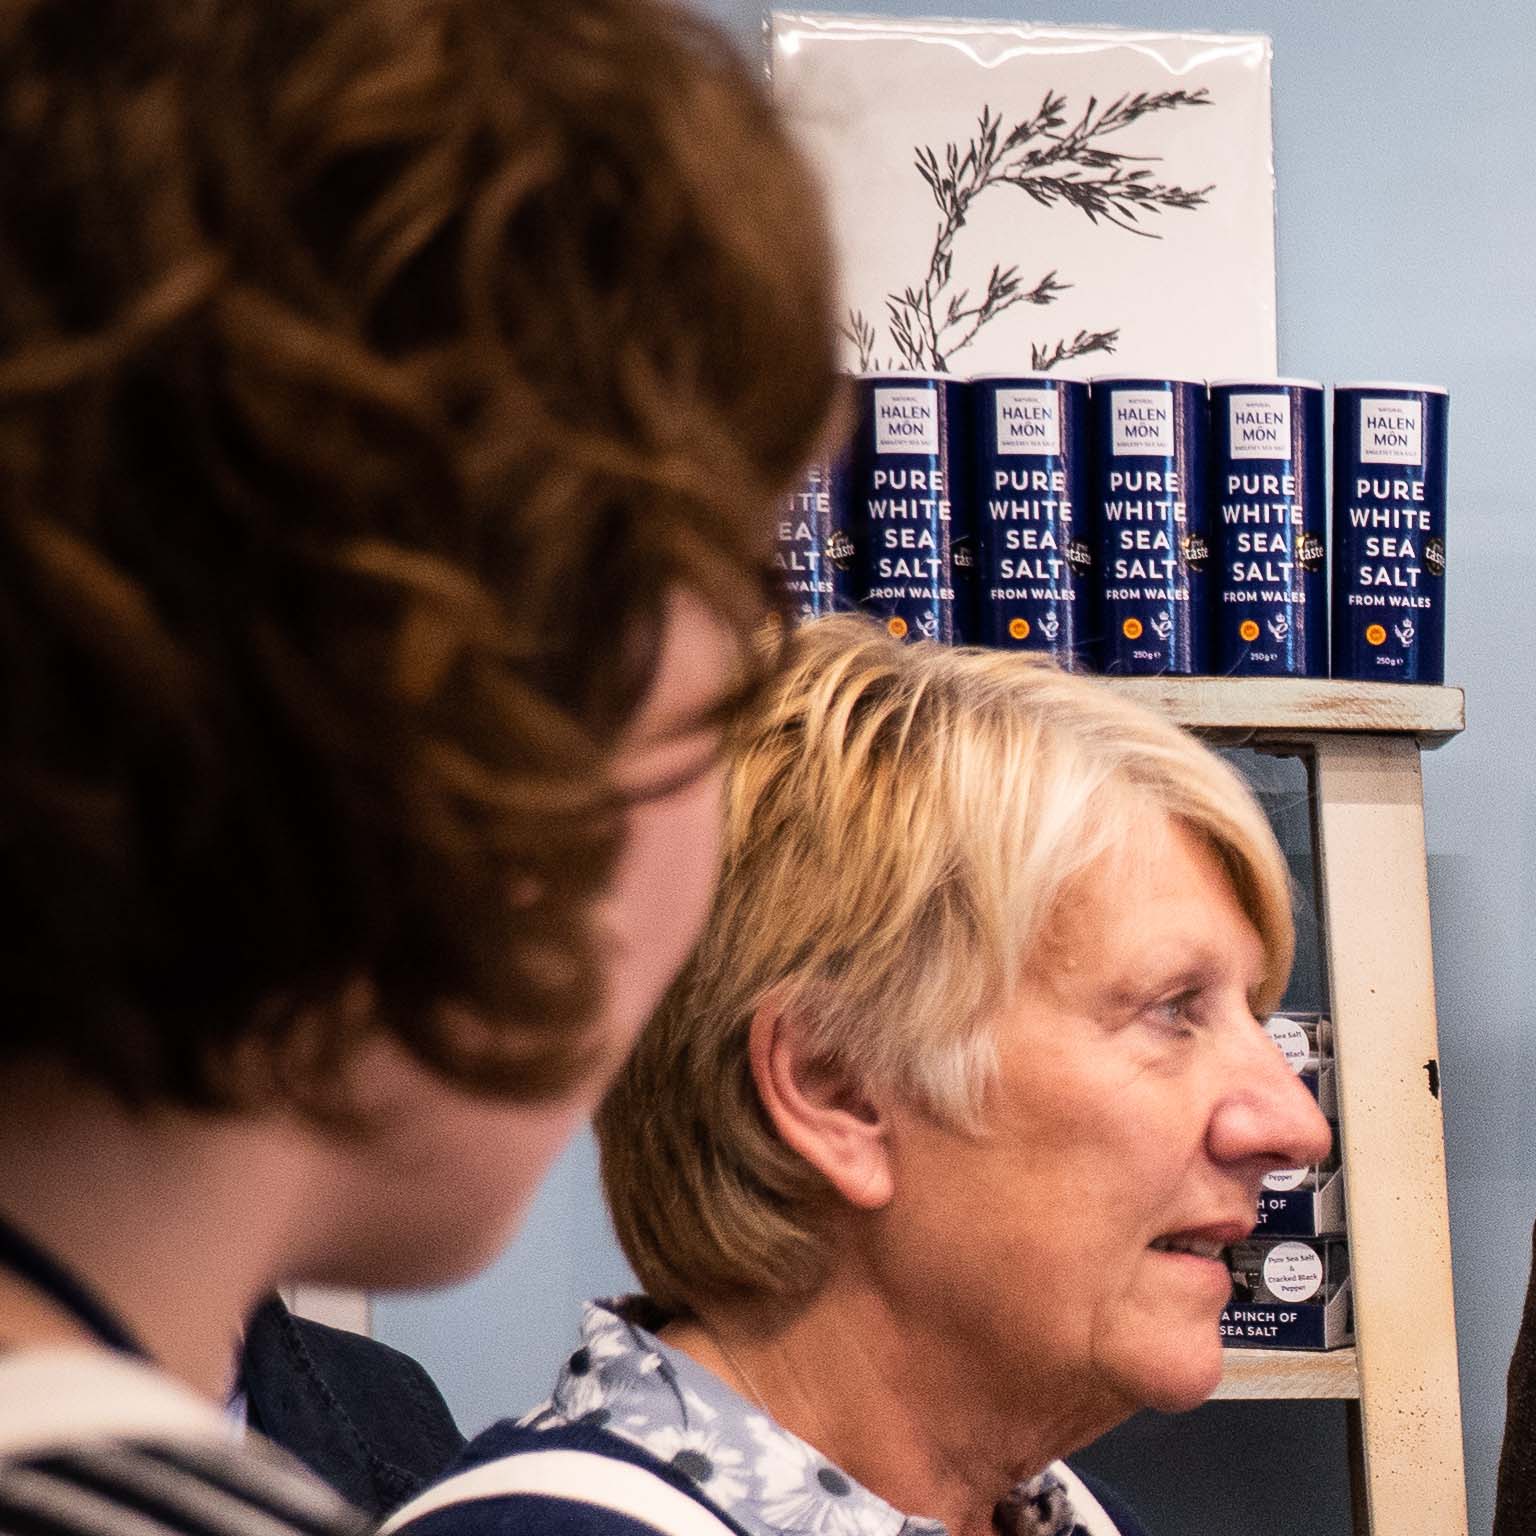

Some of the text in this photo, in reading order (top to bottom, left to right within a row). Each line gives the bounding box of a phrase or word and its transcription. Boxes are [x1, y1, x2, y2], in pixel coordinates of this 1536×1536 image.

[881, 407, 931, 419] HALEN
[1002, 408, 1052, 420] HALEN
[1118, 408, 1166, 420] HALEN
[1236, 411, 1284, 424] HALEN
[888, 420, 923, 435] MÔN
[1010, 420, 1045, 436] MÔN
[1125, 422, 1159, 437] MÔN
[1243, 426, 1277, 441] MÔN
[1367, 416, 1416, 431] HALEN
[1374, 431, 1408, 446] MÔN
[874, 470, 943, 491] PURE
[995, 471, 1065, 492] PURE
[1111, 472, 1179, 492] PURE
[1228, 475, 1295, 495] PURE
[1357, 479, 1424, 501] PURE
[868, 500, 951, 521] WHITE
[989, 501, 1072, 522] WHITE
[1105, 501, 1186, 523] WHITE
[1223, 504, 1303, 525] WHITE
[1350, 508, 1431, 531] WHITE
[885, 529, 935, 549] SEA
[1006, 530, 1058, 550] SEA
[1120, 530, 1170, 550] SEA
[1237, 533, 1287, 553] SEA
[1366, 538, 1416, 559] SEA
[879, 558, 942, 579] SALT
[1001, 559, 1064, 580] SALT
[1115, 559, 1176, 580] SALT
[1232, 562, 1294, 582] SALT
[1360, 566, 1421, 587] SALT
[869, 587, 954, 600] FROM WALES
[991, 589, 1076, 601] FROM WALES
[1106, 589, 1190, 601] FROM WALES
[1224, 591, 1306, 604] FROM WALES
[1349, 595, 1431, 609] FROM WALES
[1270, 1200, 1287, 1209] OF
[1222, 1312, 1297, 1322] A PINCH OF
[1220, 1326, 1278, 1336] SEA SALT
